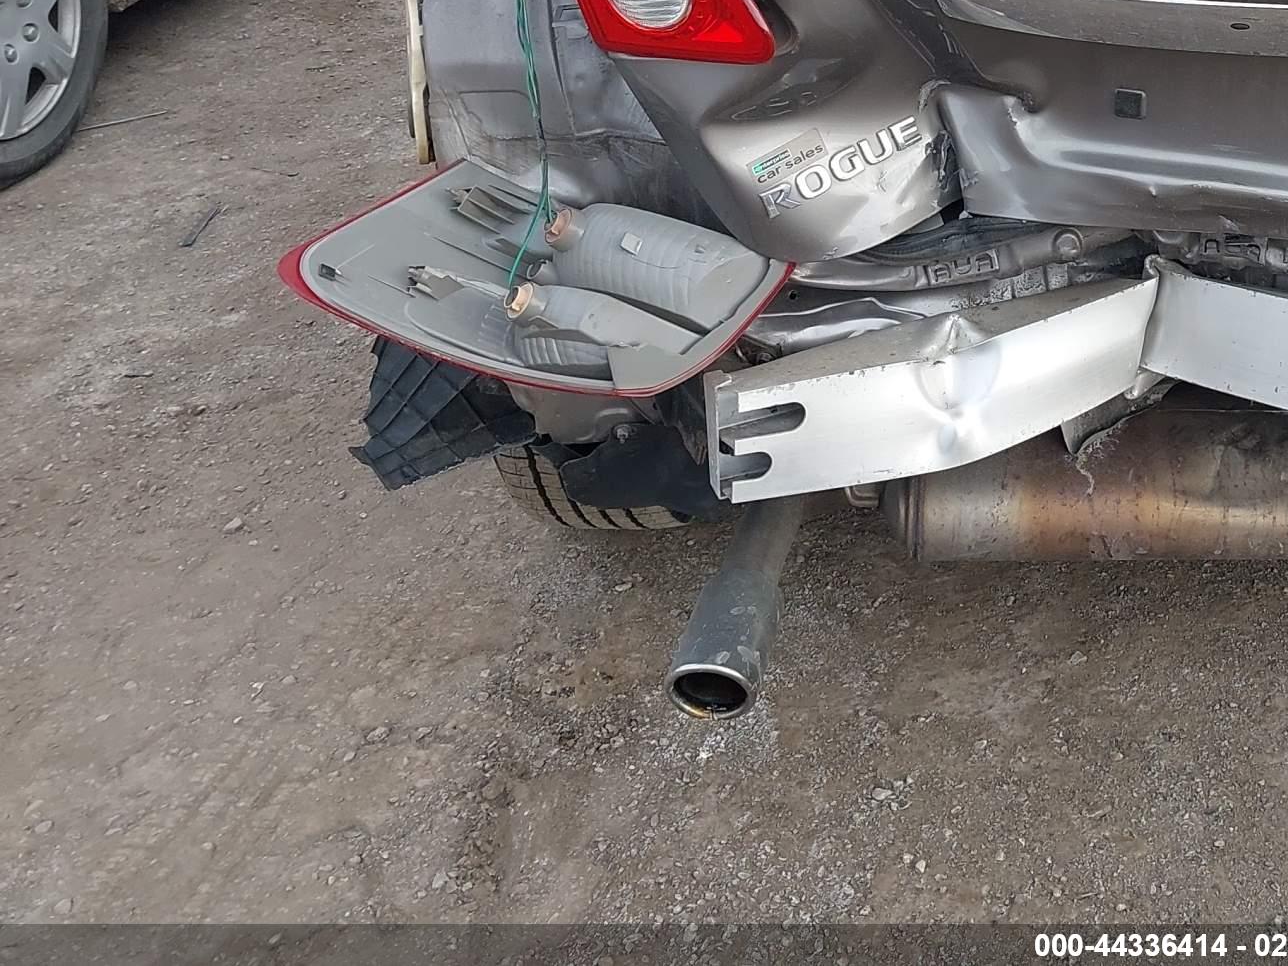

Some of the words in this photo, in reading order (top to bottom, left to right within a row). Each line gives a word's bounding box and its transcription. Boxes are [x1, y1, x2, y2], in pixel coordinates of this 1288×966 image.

[757, 165, 782, 184] car
[785, 144, 824, 169] sales
[758, 115, 924, 219] ROGUE
